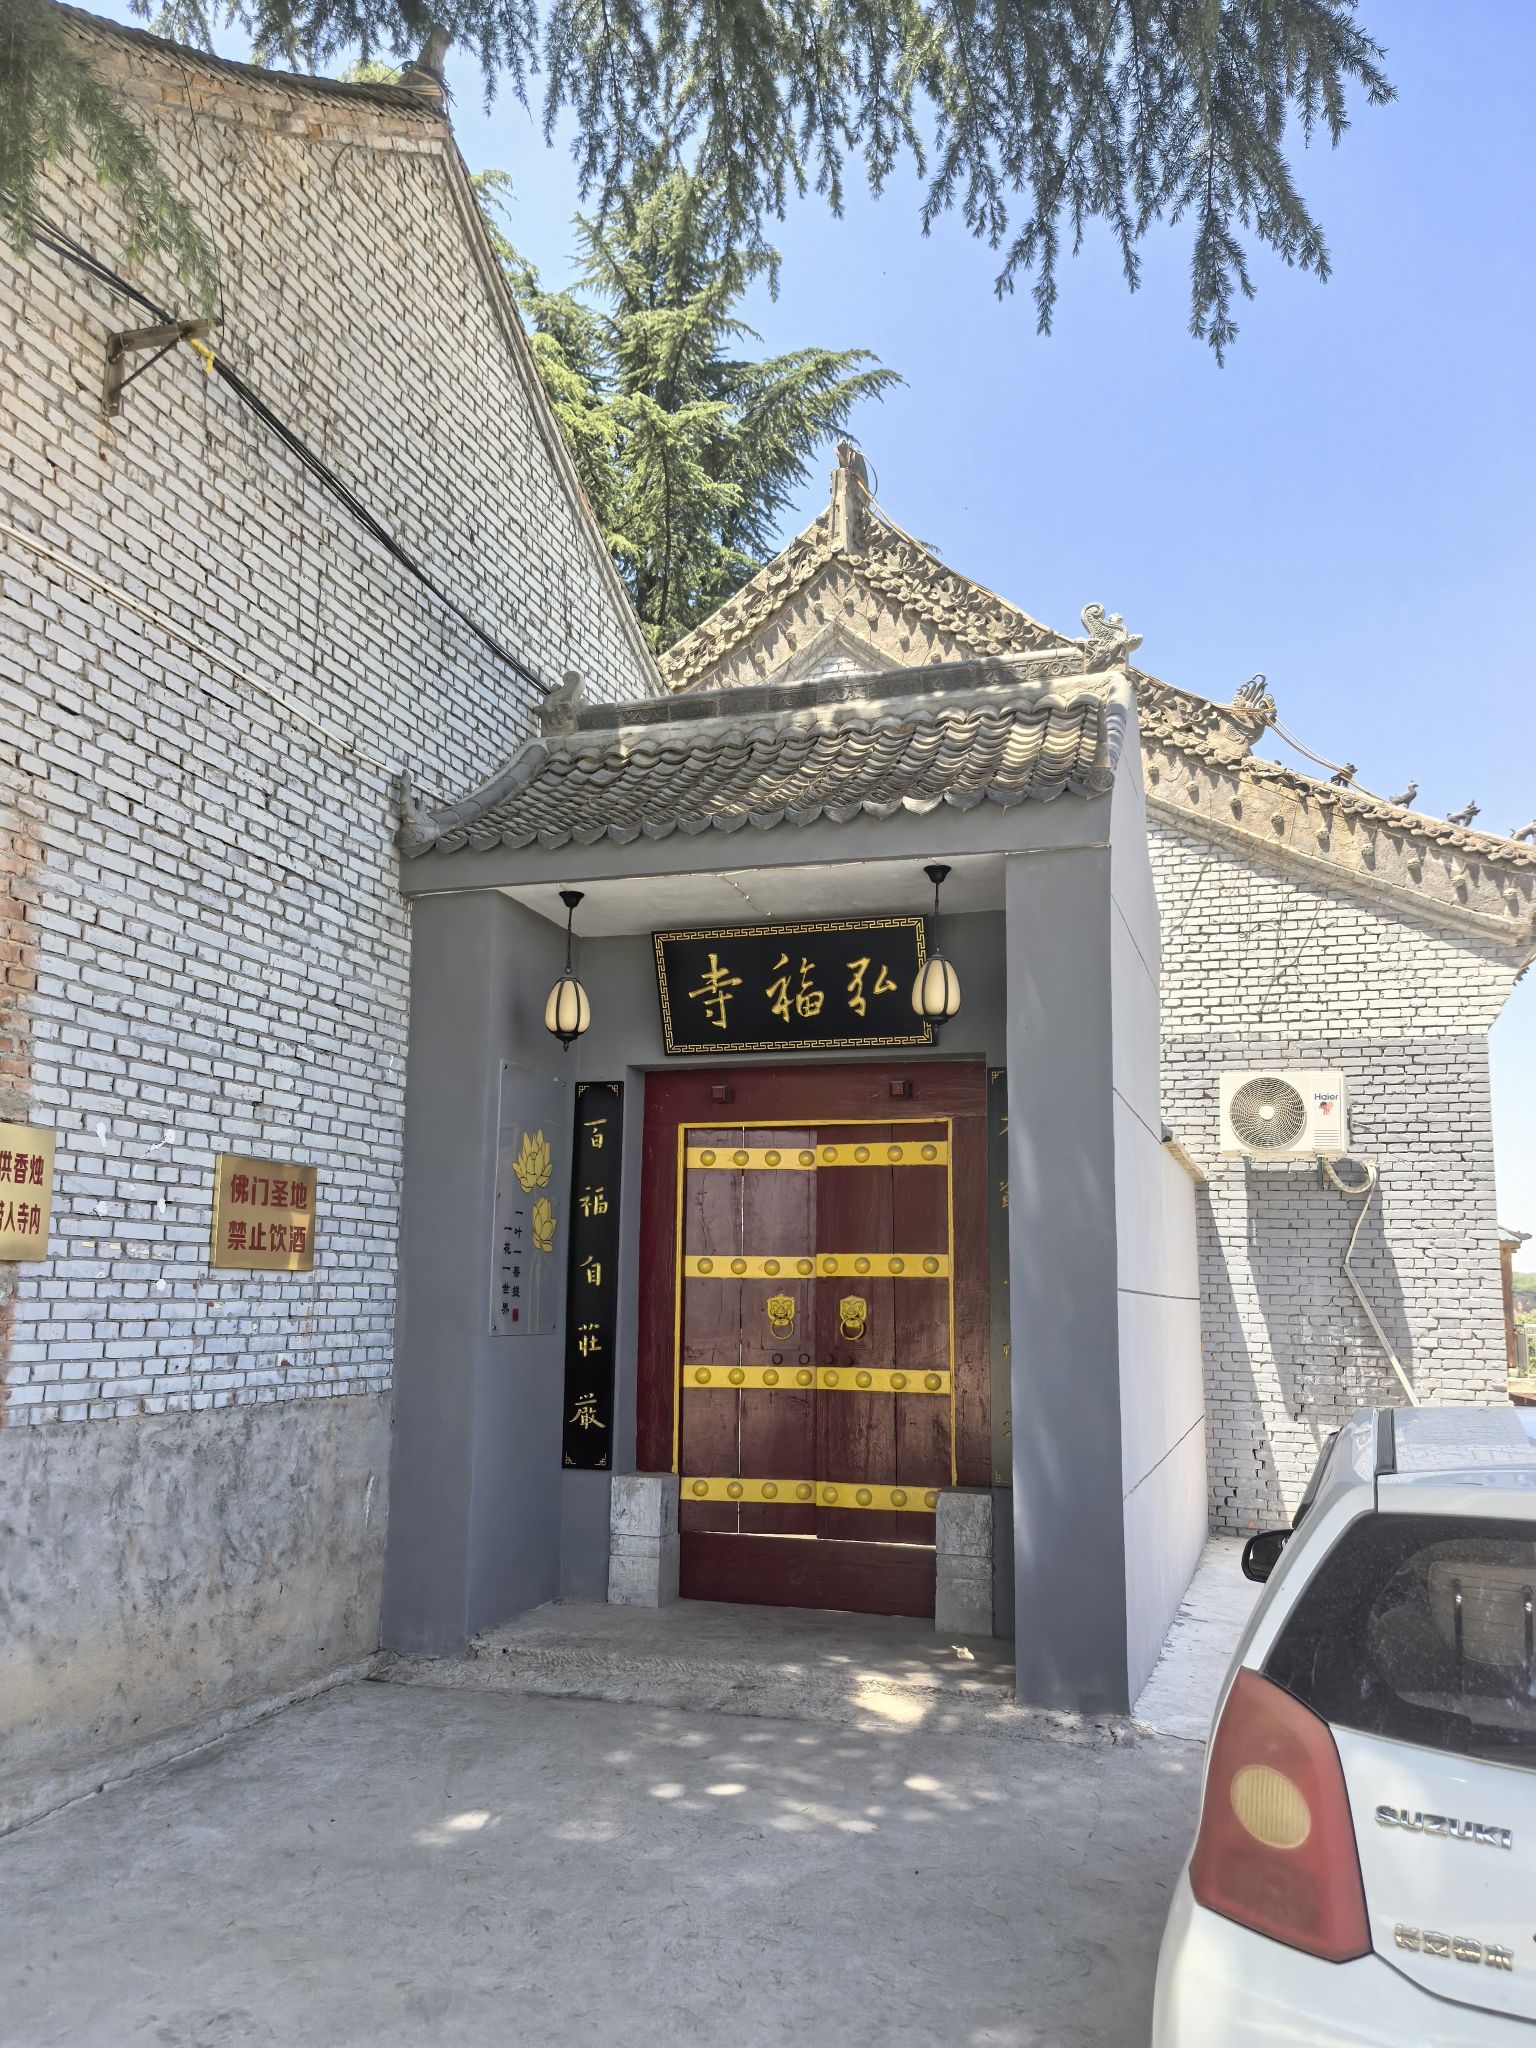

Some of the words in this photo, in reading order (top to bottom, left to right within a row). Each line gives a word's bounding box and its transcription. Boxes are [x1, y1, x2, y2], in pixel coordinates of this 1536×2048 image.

[1314, 1092, 1339, 1101] Haier
[230, 1173, 308, 1210] 佛门圣地
[227, 1220, 307, 1254] 禁止饮酒
[511, 1210, 524, 1298] 一叶一菩提
[500, 1226, 513, 1316] 一花一世界
[1374, 1805, 1513, 1851] SUZUKI
